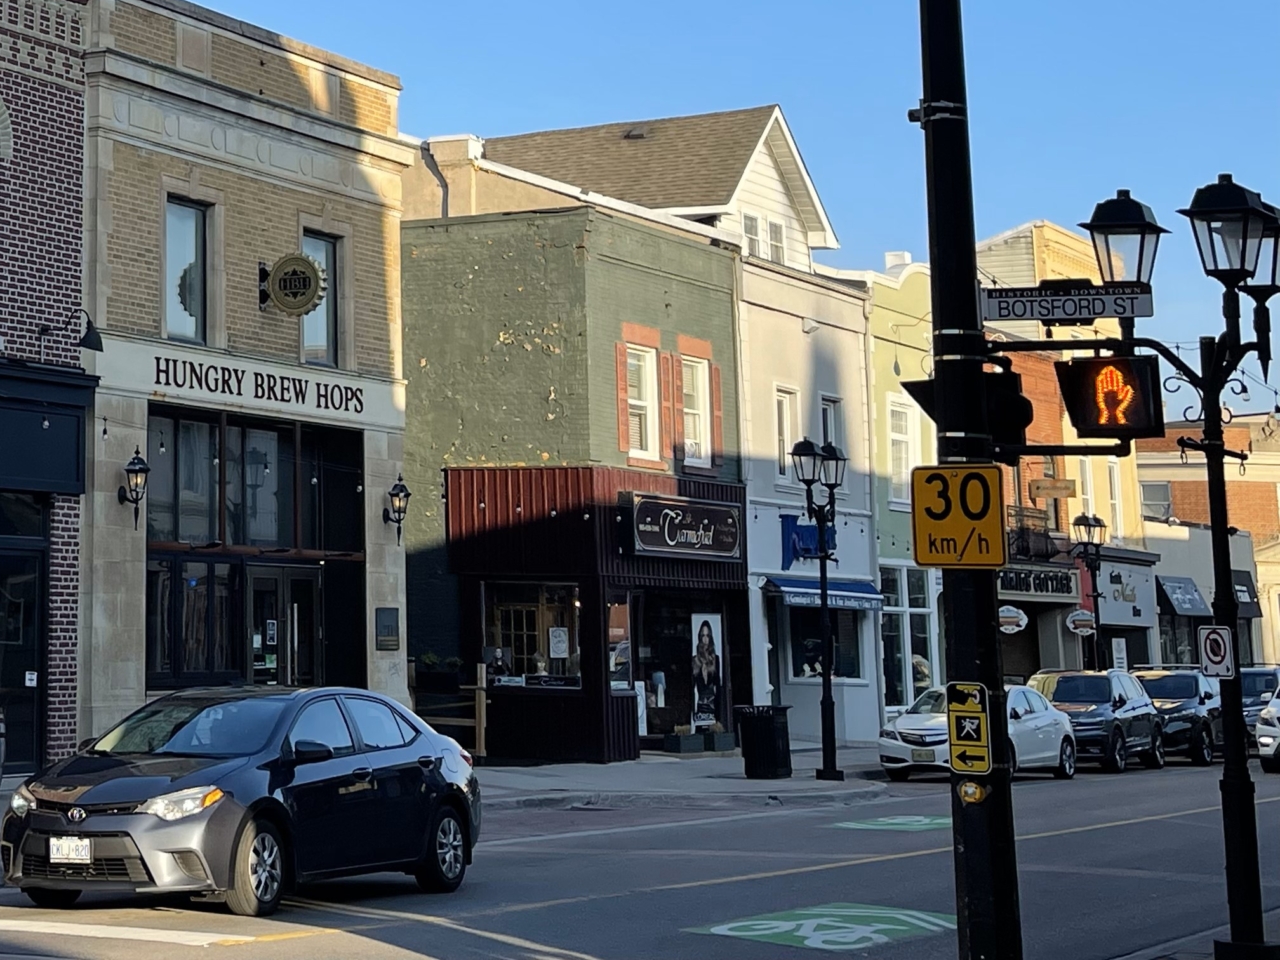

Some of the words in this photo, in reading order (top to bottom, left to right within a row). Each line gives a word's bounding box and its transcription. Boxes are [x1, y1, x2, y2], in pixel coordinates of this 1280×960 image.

[992, 290, 1055, 298] HISTORIC
[1070, 287, 1142, 296] DOWNTOWN
[997, 297, 1106, 318] BOTSFORD
[1113, 296, 1139, 315] ST
[154, 356, 247, 396] HUNGRY
[253, 372, 310, 405] BREW
[315, 382, 364, 414] HOPS
[923, 471, 991, 522] 30
[928, 526, 990, 562] km/h
[74, 844, 89, 858] 820
